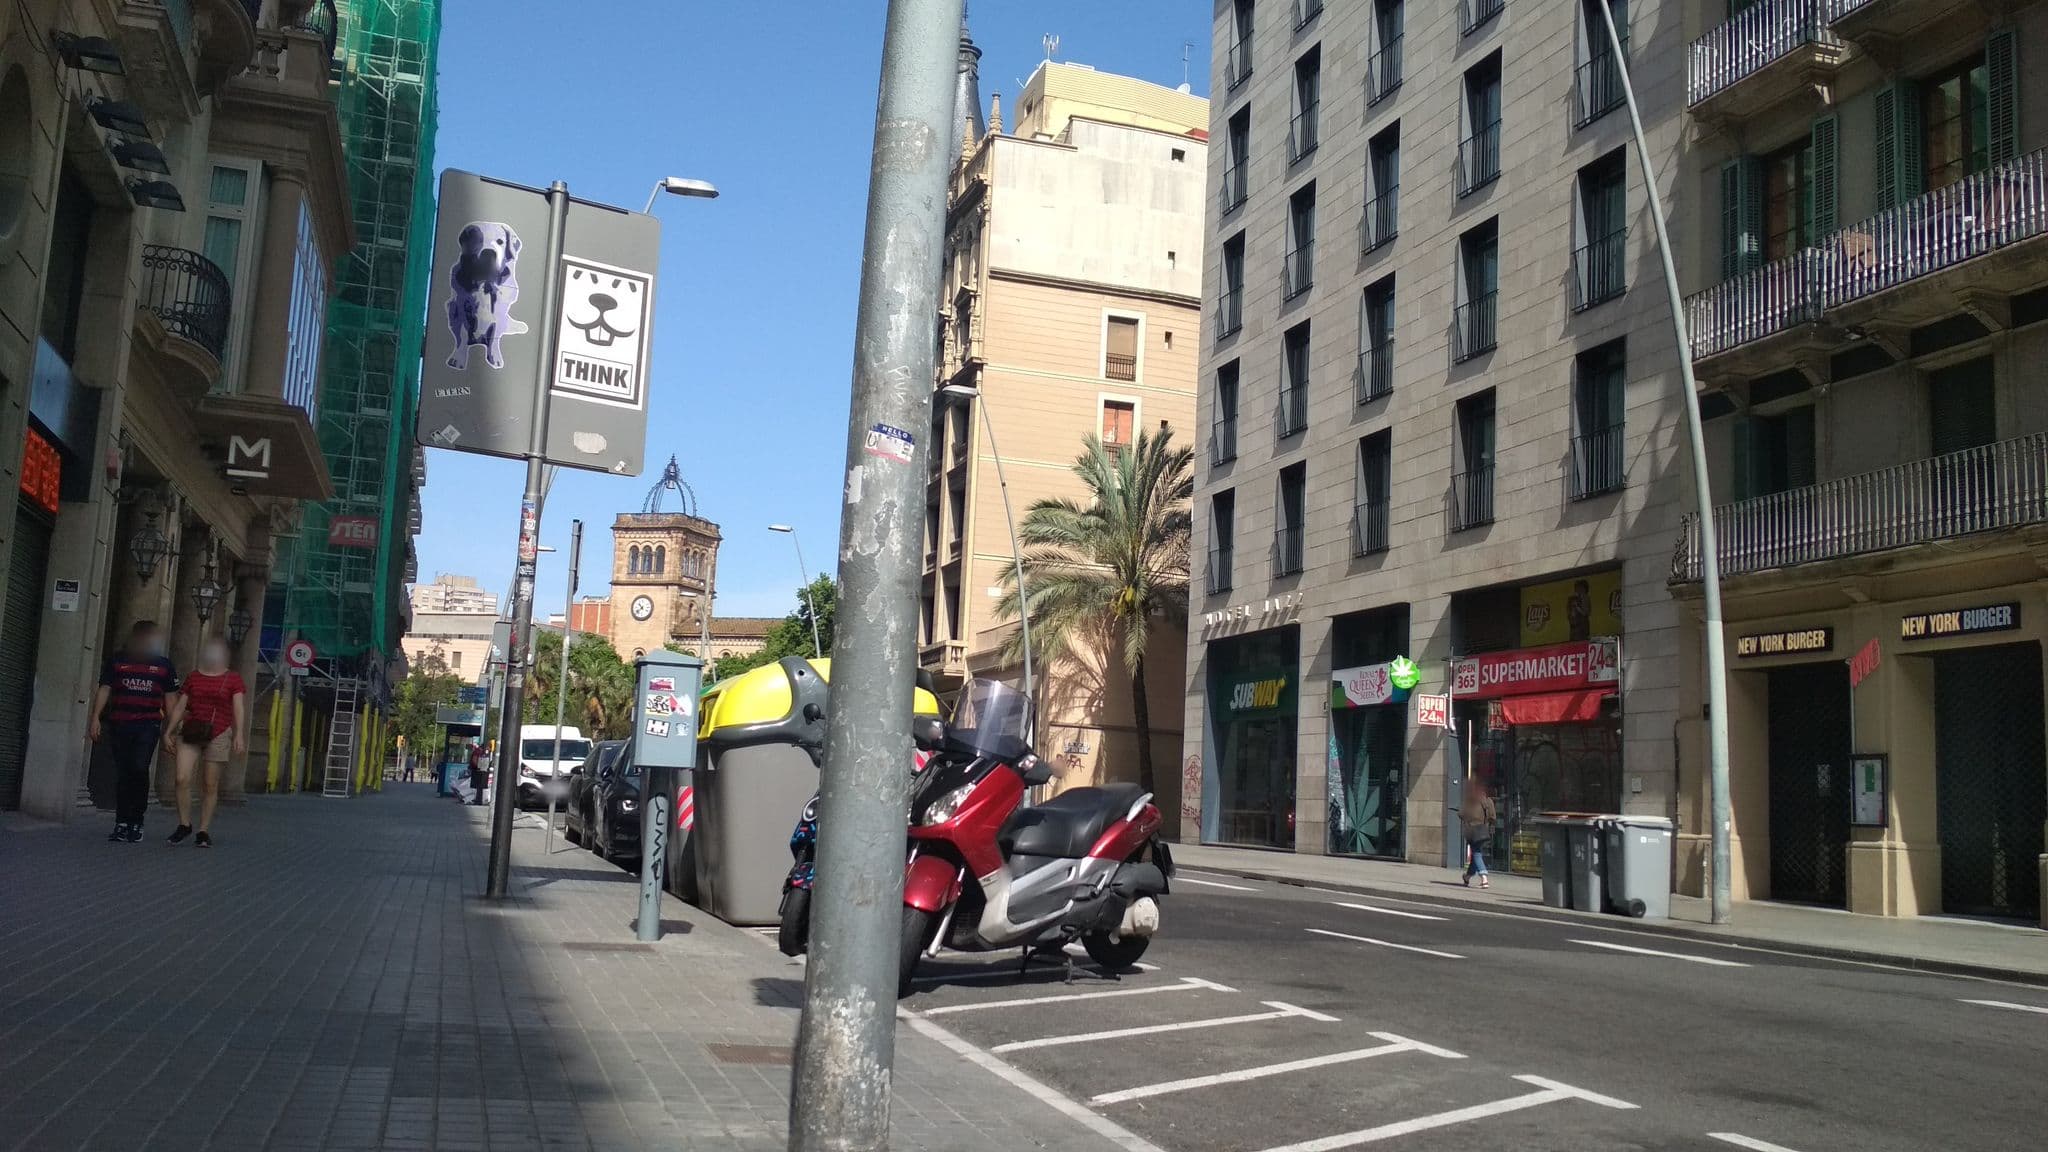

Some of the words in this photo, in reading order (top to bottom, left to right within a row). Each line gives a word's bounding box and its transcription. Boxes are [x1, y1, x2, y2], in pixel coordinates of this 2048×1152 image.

[564, 358, 629, 389] THINK
[228, 436, 271, 468] M
[1902, 615, 1926, 637] NEW
[1930, 609, 1960, 633] YORK
[1963, 605, 2012, 629] BURGER
[1738, 635, 1758, 655] NEW
[1759, 633, 1785, 652] YORK
[1787, 630, 1825, 650] BURGER
[1458, 663, 1475, 673] OPEN
[1481, 653, 1587, 685] SUPERMARKET
[1589, 645, 1605, 670] 24
[122, 679, 153, 687] QATAR
[1230, 679, 1285, 710] SUBWAY
[1458, 674, 1475, 689] 365
